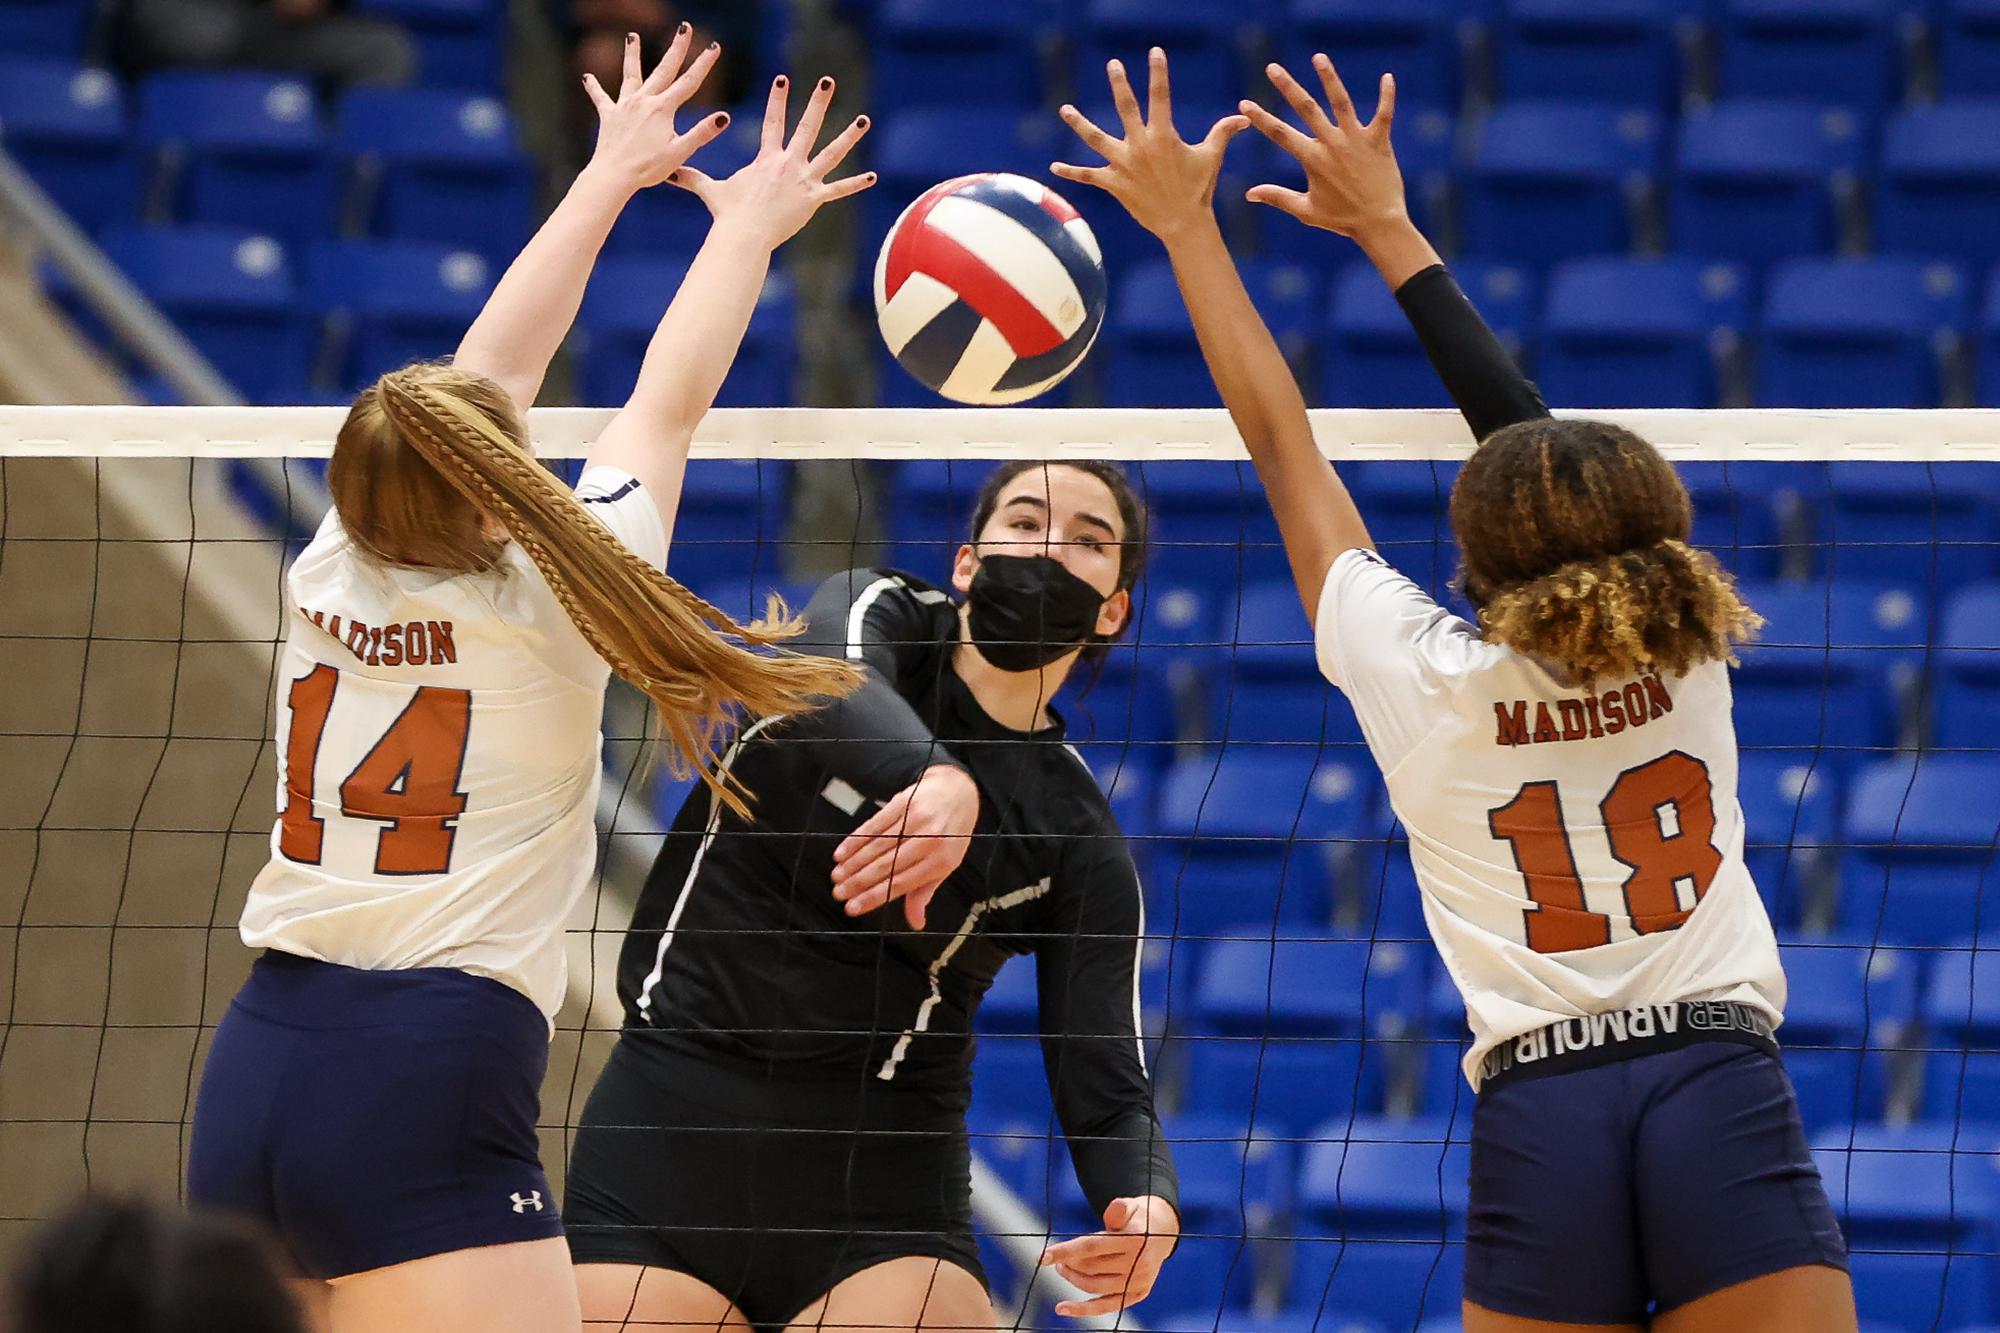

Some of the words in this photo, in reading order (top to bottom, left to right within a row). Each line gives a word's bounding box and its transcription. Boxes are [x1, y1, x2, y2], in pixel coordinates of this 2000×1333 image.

[300, 607, 457, 666] DISON
[275, 661, 473, 876] 14
[1493, 671, 1673, 748] MADISON
[1487, 749, 1724, 954] 18
